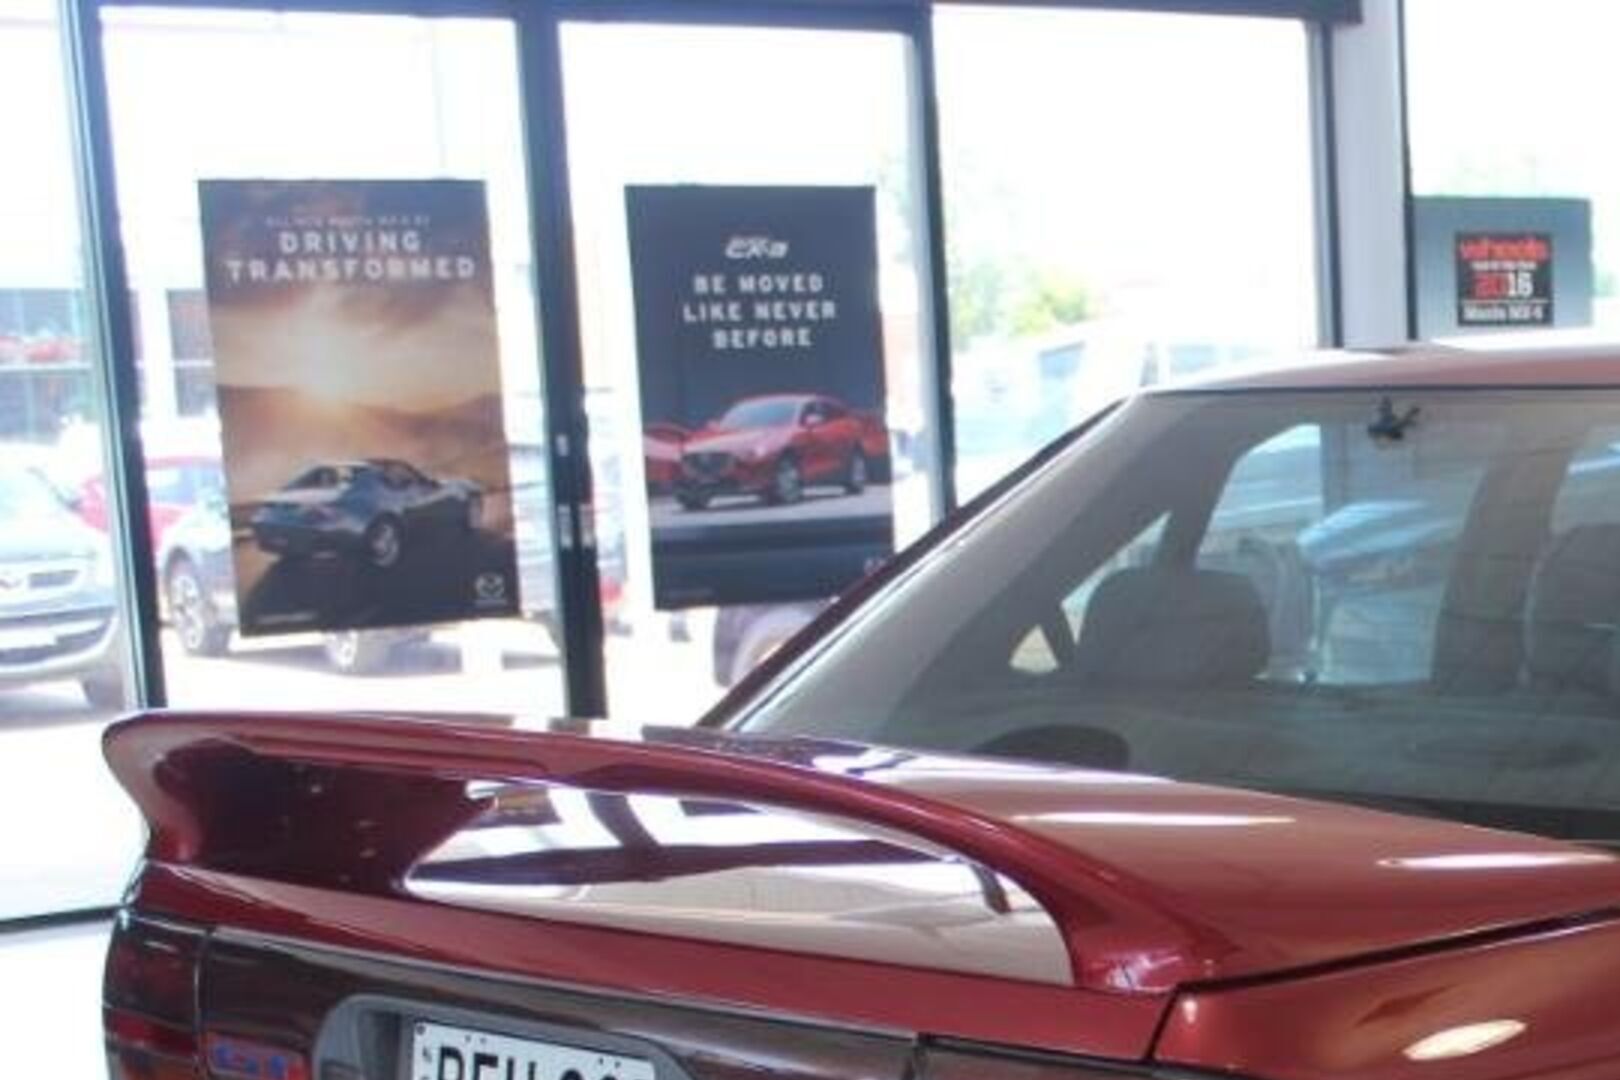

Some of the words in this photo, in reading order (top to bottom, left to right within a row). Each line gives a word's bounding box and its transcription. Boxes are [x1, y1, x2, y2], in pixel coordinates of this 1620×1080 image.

[279, 231, 421, 252] DRIVING
[227, 258, 477, 281] TRANSFORMED
[694, 274, 726, 294] BE
[739, 273, 823, 293] MOVED
[683, 302, 742, 322] LIKE
[755, 300, 836, 321] NEVER
[713, 328, 813, 349] BEFORE
